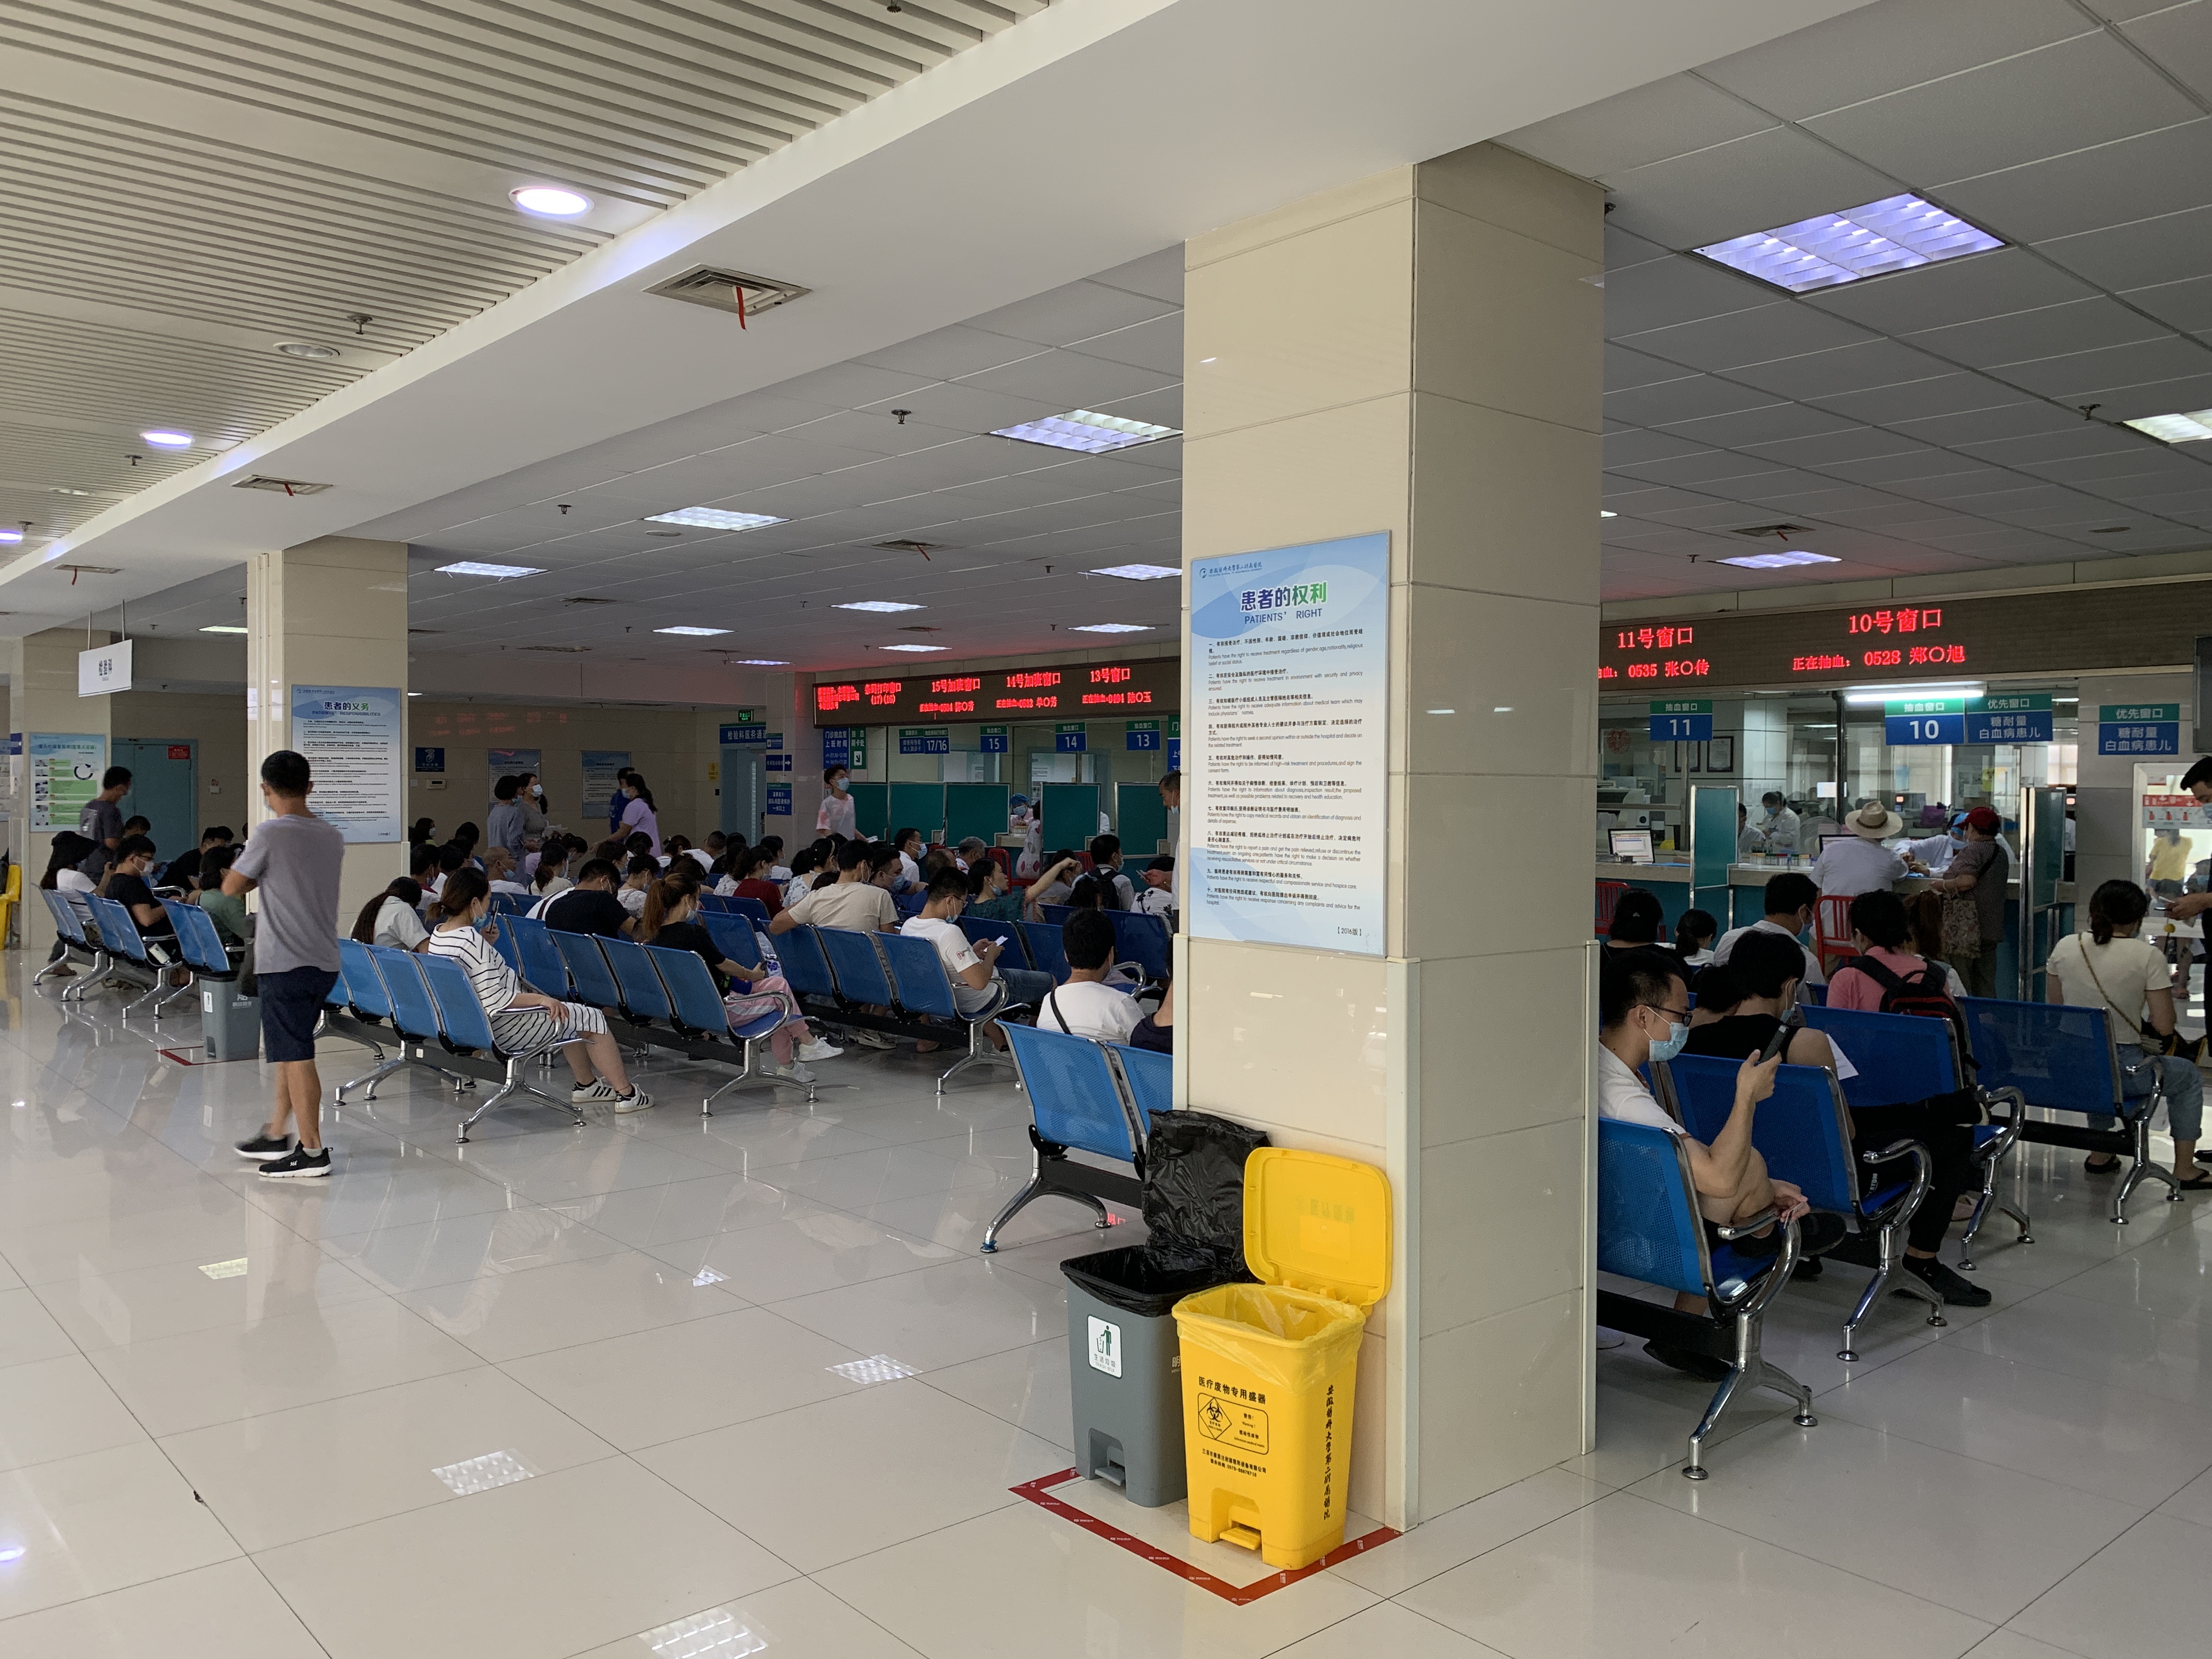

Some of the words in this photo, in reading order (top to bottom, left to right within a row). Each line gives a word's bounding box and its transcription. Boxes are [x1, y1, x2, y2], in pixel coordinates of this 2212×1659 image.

[1241, 582, 1327, 611] 患者的权利
[1296, 609, 1323, 619] RIGHT
[1849, 608, 1942, 634] 10号窗口
[1618, 627, 1692, 648] 11号窗口
[1864, 650, 1901, 665] 0528
[1090, 667, 1130, 683] 13号窗口
[1628, 663, 1657, 678] 0535
[932, 678, 980, 692] 15号加班窗口
[1006, 672, 1060, 688] 14号加班窗口
[871, 694, 883, 705] (17)
[883, 694, 896, 705] (16)
[1988, 698, 2030, 709] 优先窗口
[324, 702, 369, 711] 患者的义务
[1666, 703, 1698, 712] 抽血窗口
[1904, 702, 1944, 713] 抽血窗口
[2116, 708, 2163, 719] 优先窗口
[1990, 715, 2027, 727] 糖耐量
[1669, 719, 1690, 736] 11
[1909, 719, 1939, 740] 10
[1979, 727, 2041, 739] 白血病患儿
[2118, 727, 2158, 738] 糖耐量
[825, 740, 848, 748] 上班时间
[927, 740, 947, 751] 17/16
[989, 738, 1000, 749] 15
[1065, 736, 1077, 748] 14
[1136, 734, 1150, 747] 13
[2105, 740, 2171, 752] 白血病患儿
[1094, 1353, 1116, 1368] 生活垃圾
[1172, 1356, 1181, 1367] 明
[1199, 1376, 1266, 1404] 医疗废物专用盛器
